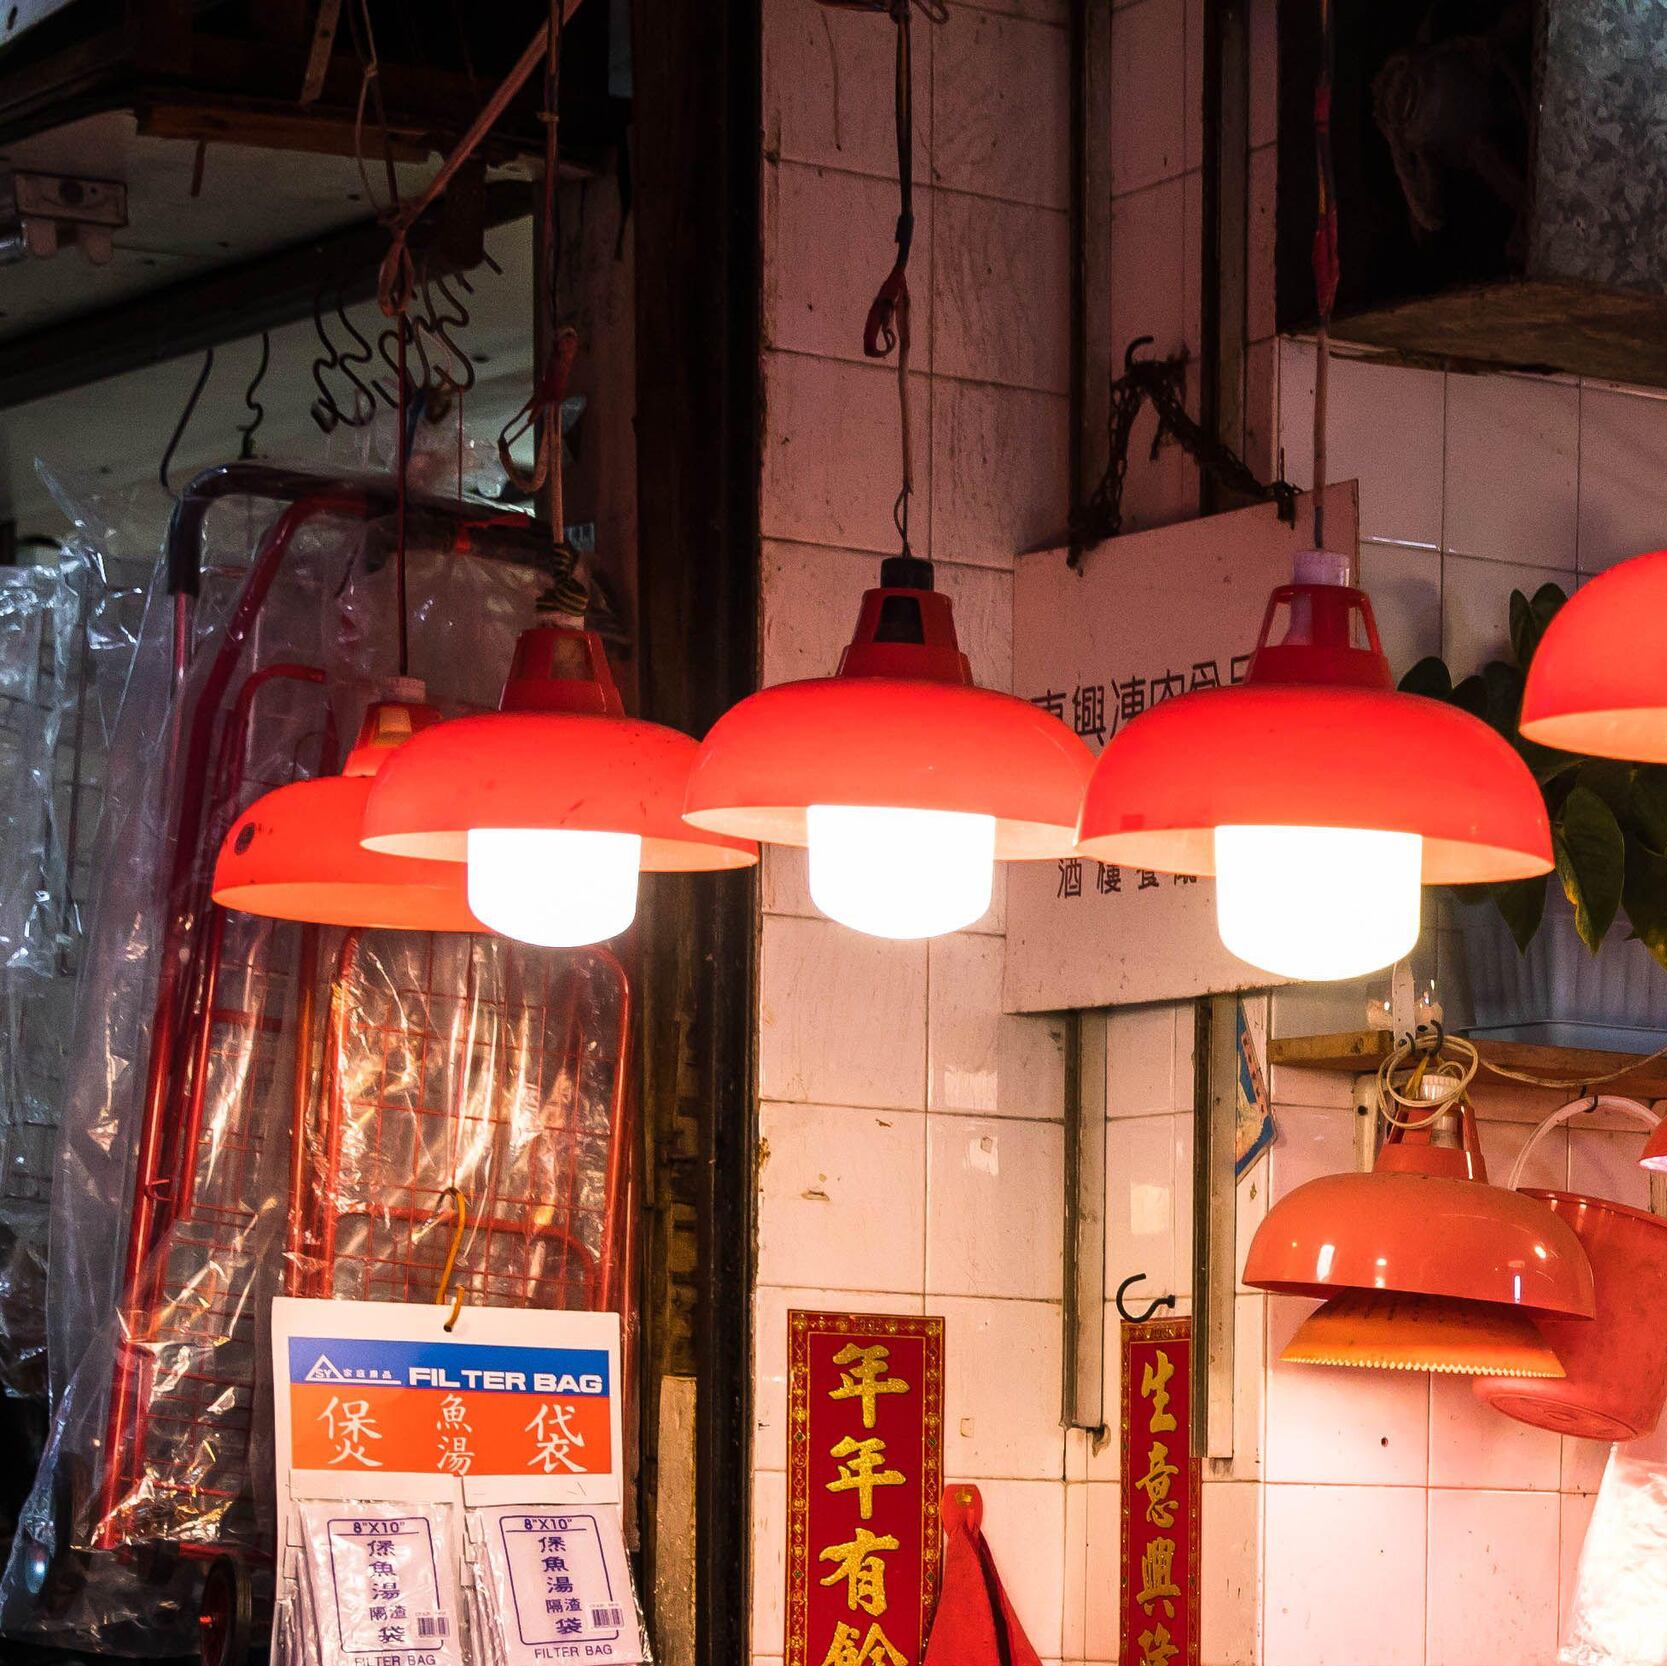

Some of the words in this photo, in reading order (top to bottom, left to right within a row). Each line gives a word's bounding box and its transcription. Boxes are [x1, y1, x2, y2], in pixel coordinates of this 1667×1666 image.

[408, 1366, 528, 1391] FILTER
[533, 1372, 603, 1394] BAG
[524, 1518, 573, 1530] 8"X10"
[534, 1647, 580, 1659] FILTER
[585, 1644, 613, 1656] BAG
[407, 1654, 437, 1666] BAG
